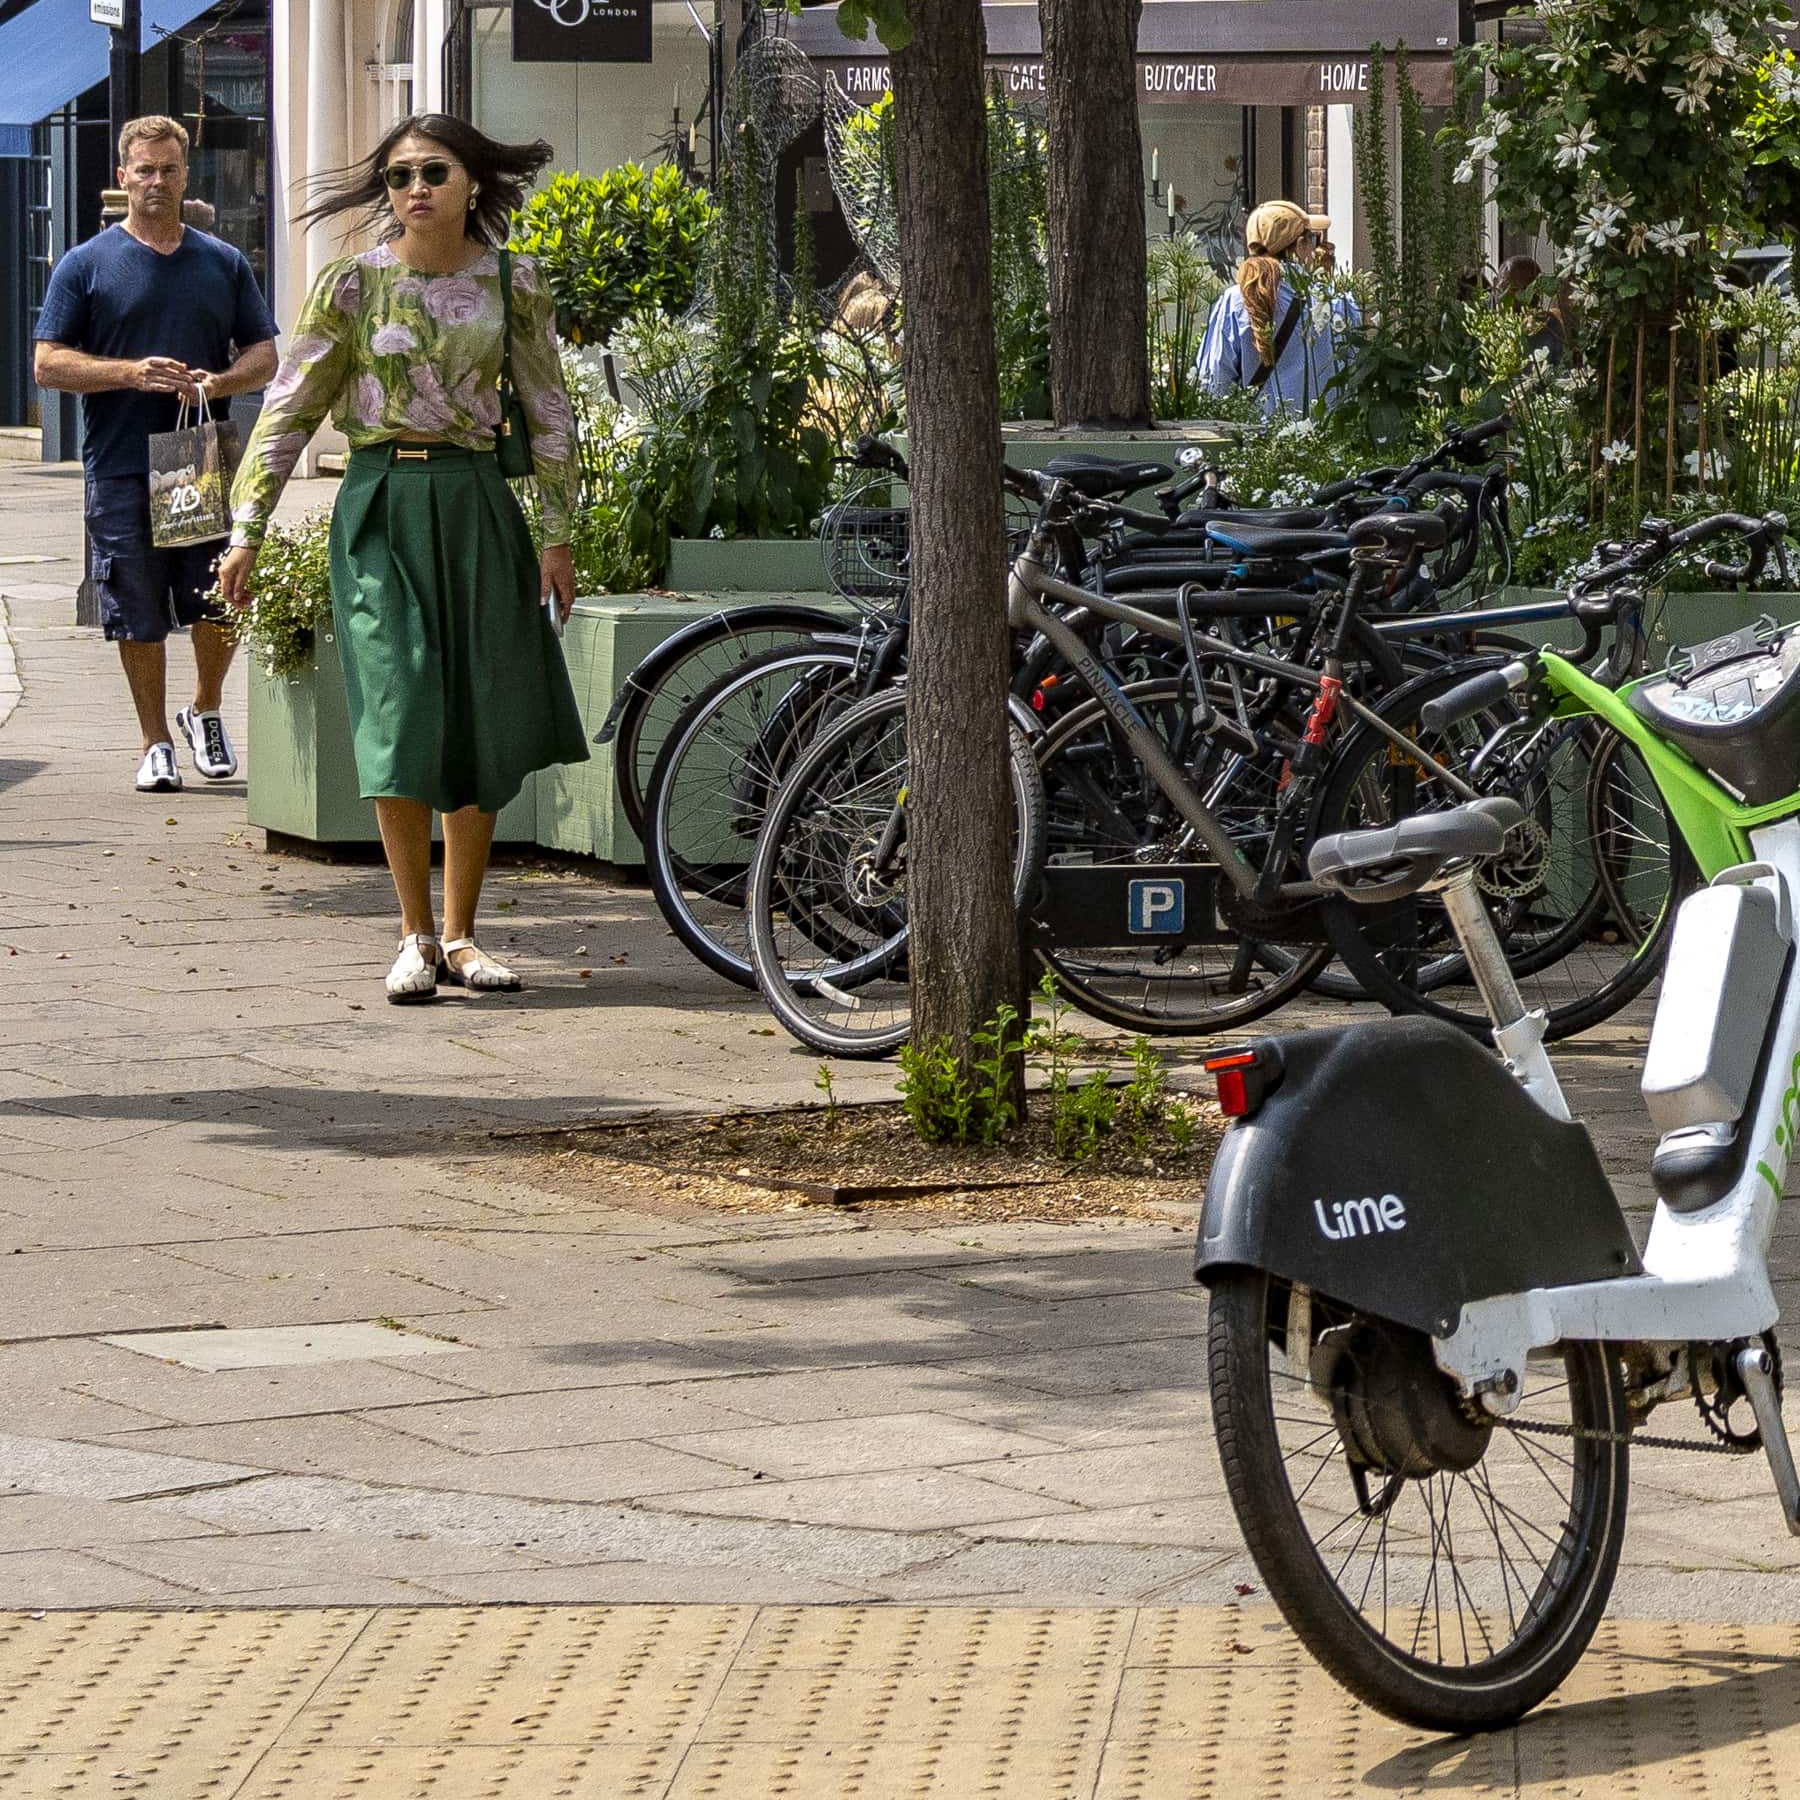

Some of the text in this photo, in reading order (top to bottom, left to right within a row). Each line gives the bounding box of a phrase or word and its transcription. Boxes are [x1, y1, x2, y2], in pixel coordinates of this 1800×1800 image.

[94, 1, 120, 17] emissions
[593, 8, 638, 17] LONDON
[847, 66, 893, 92] FARMS
[1145, 64, 1217, 92] BUTCHER
[1320, 63, 1369, 92] HOME
[1079, 656, 1137, 735] PINNACLE
[1142, 886, 1175, 929] P
